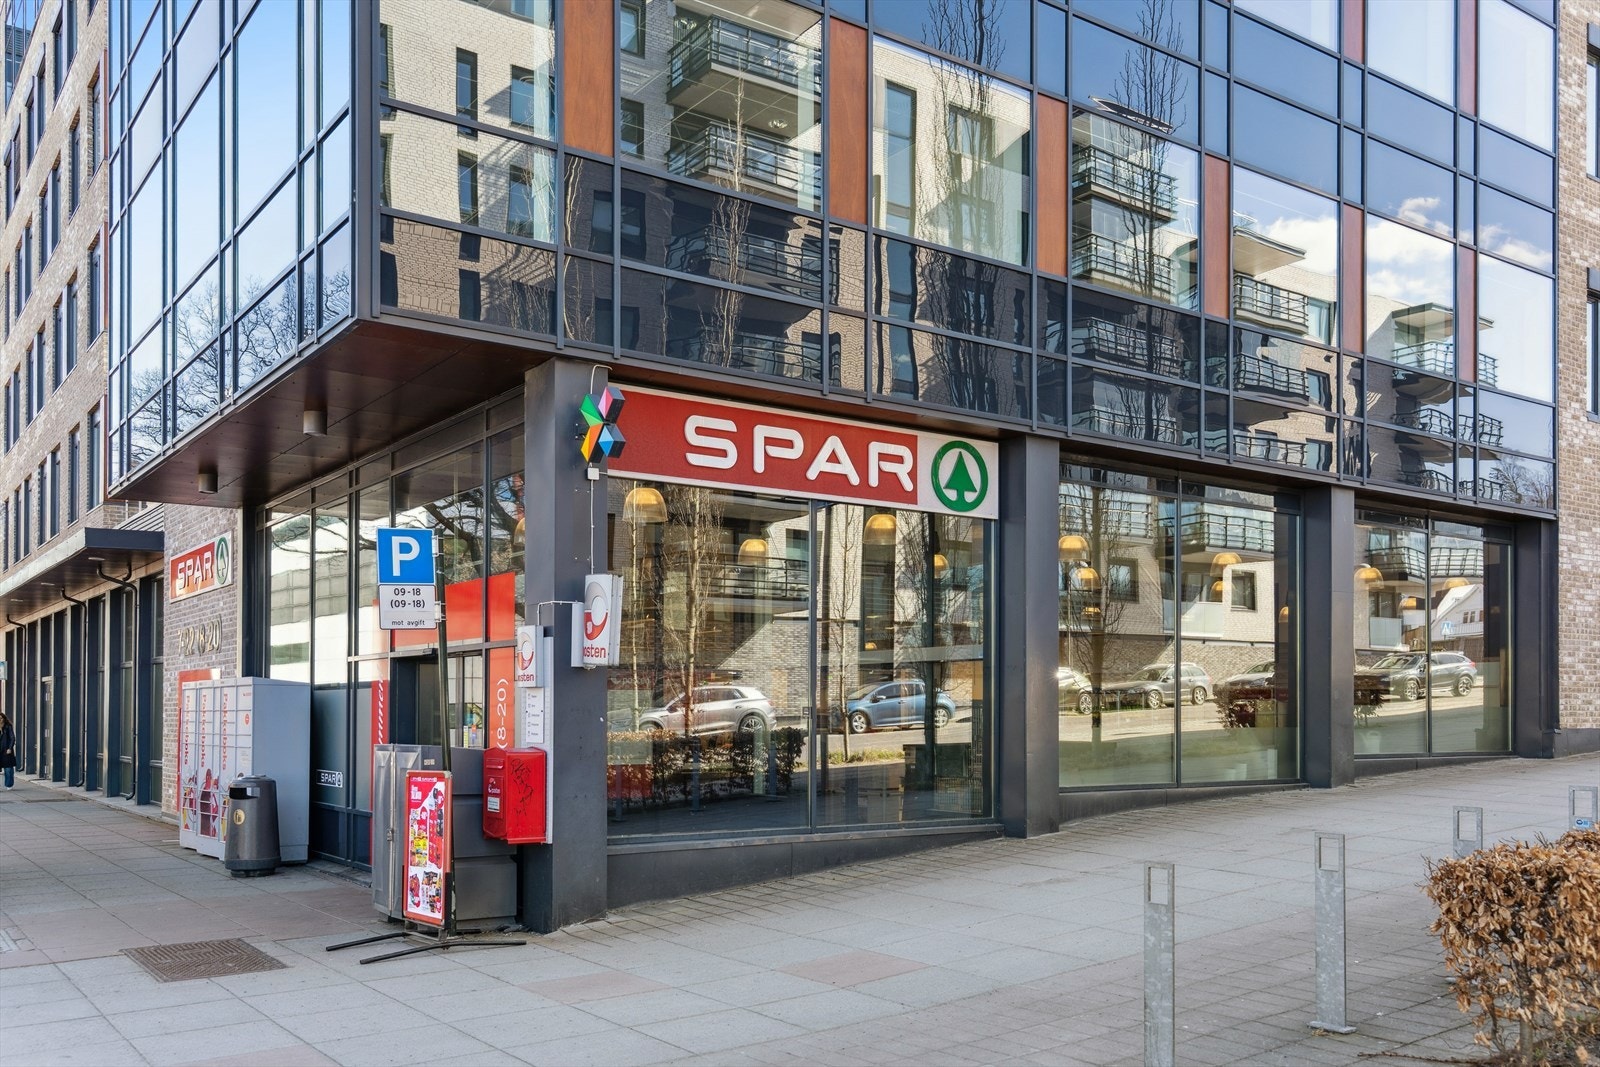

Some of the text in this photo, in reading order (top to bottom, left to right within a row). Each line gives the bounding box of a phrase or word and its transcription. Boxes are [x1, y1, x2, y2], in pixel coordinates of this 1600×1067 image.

[684, 414, 914, 493] SPAR
[177, 550, 213, 590] SPAR
[391, 535, 420, 577] P
[406, 619, 425, 627] avgift
[582, 643, 607, 659] osten
[496, 678, 509, 749] (8-20)
[320, 772, 336, 784] SPAR
